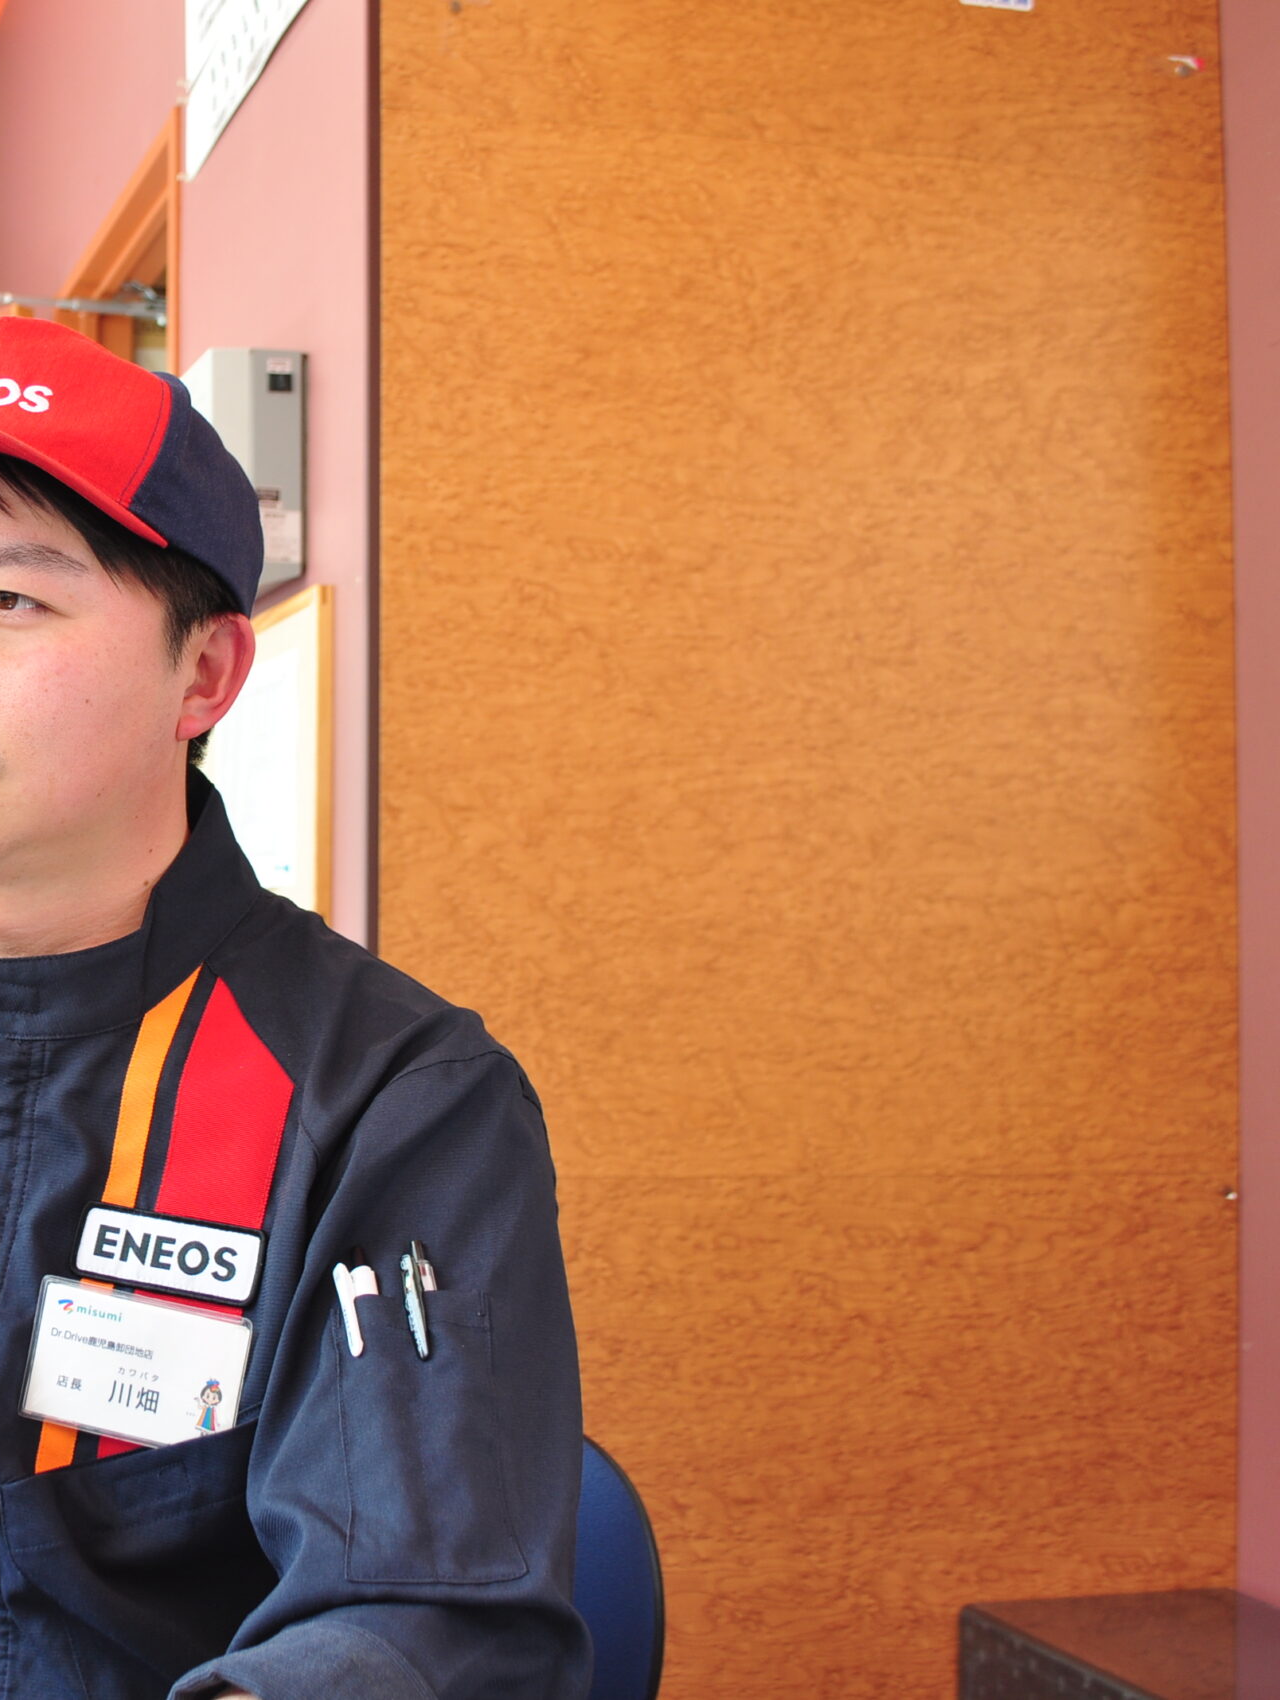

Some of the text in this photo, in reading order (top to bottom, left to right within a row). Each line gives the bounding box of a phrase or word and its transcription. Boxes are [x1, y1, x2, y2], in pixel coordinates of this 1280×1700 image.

[93, 1224, 239, 1283] ENEOS
[76, 1304, 123, 1323] misumi
[56, 1374, 83, 1391] 店長
[107, 1379, 160, 1414] 川畑
